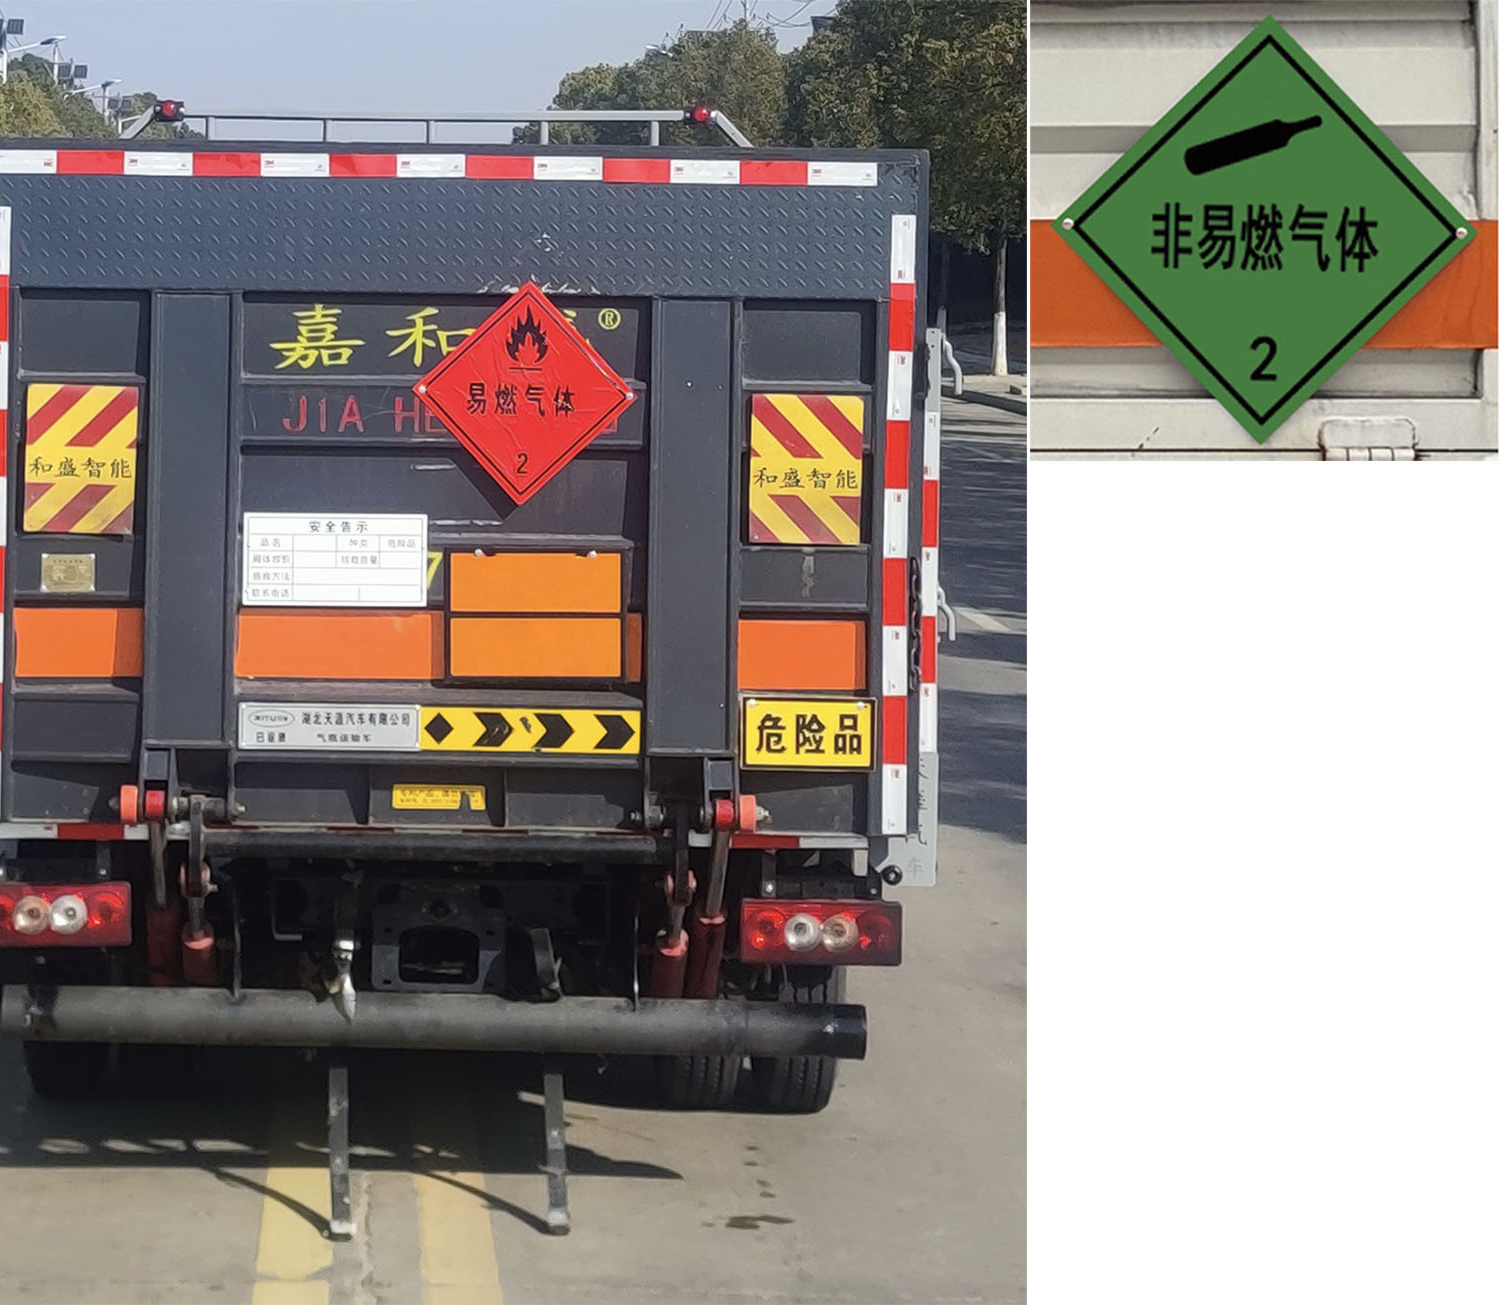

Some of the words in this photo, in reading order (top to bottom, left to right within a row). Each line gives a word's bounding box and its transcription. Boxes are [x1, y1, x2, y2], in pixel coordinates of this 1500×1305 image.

[1151, 202, 1378, 273] 非易燃气体
[1250, 336, 1277, 381] 2
[467, 382, 575, 417] 易燃气体
[29, 456, 132, 479] 和盛智能
[516, 453, 529, 474] 2
[753, 467, 859, 490] 和盛智能
[308, 521, 369, 533] 安全告示
[755, 713, 862, 756] 危险品
